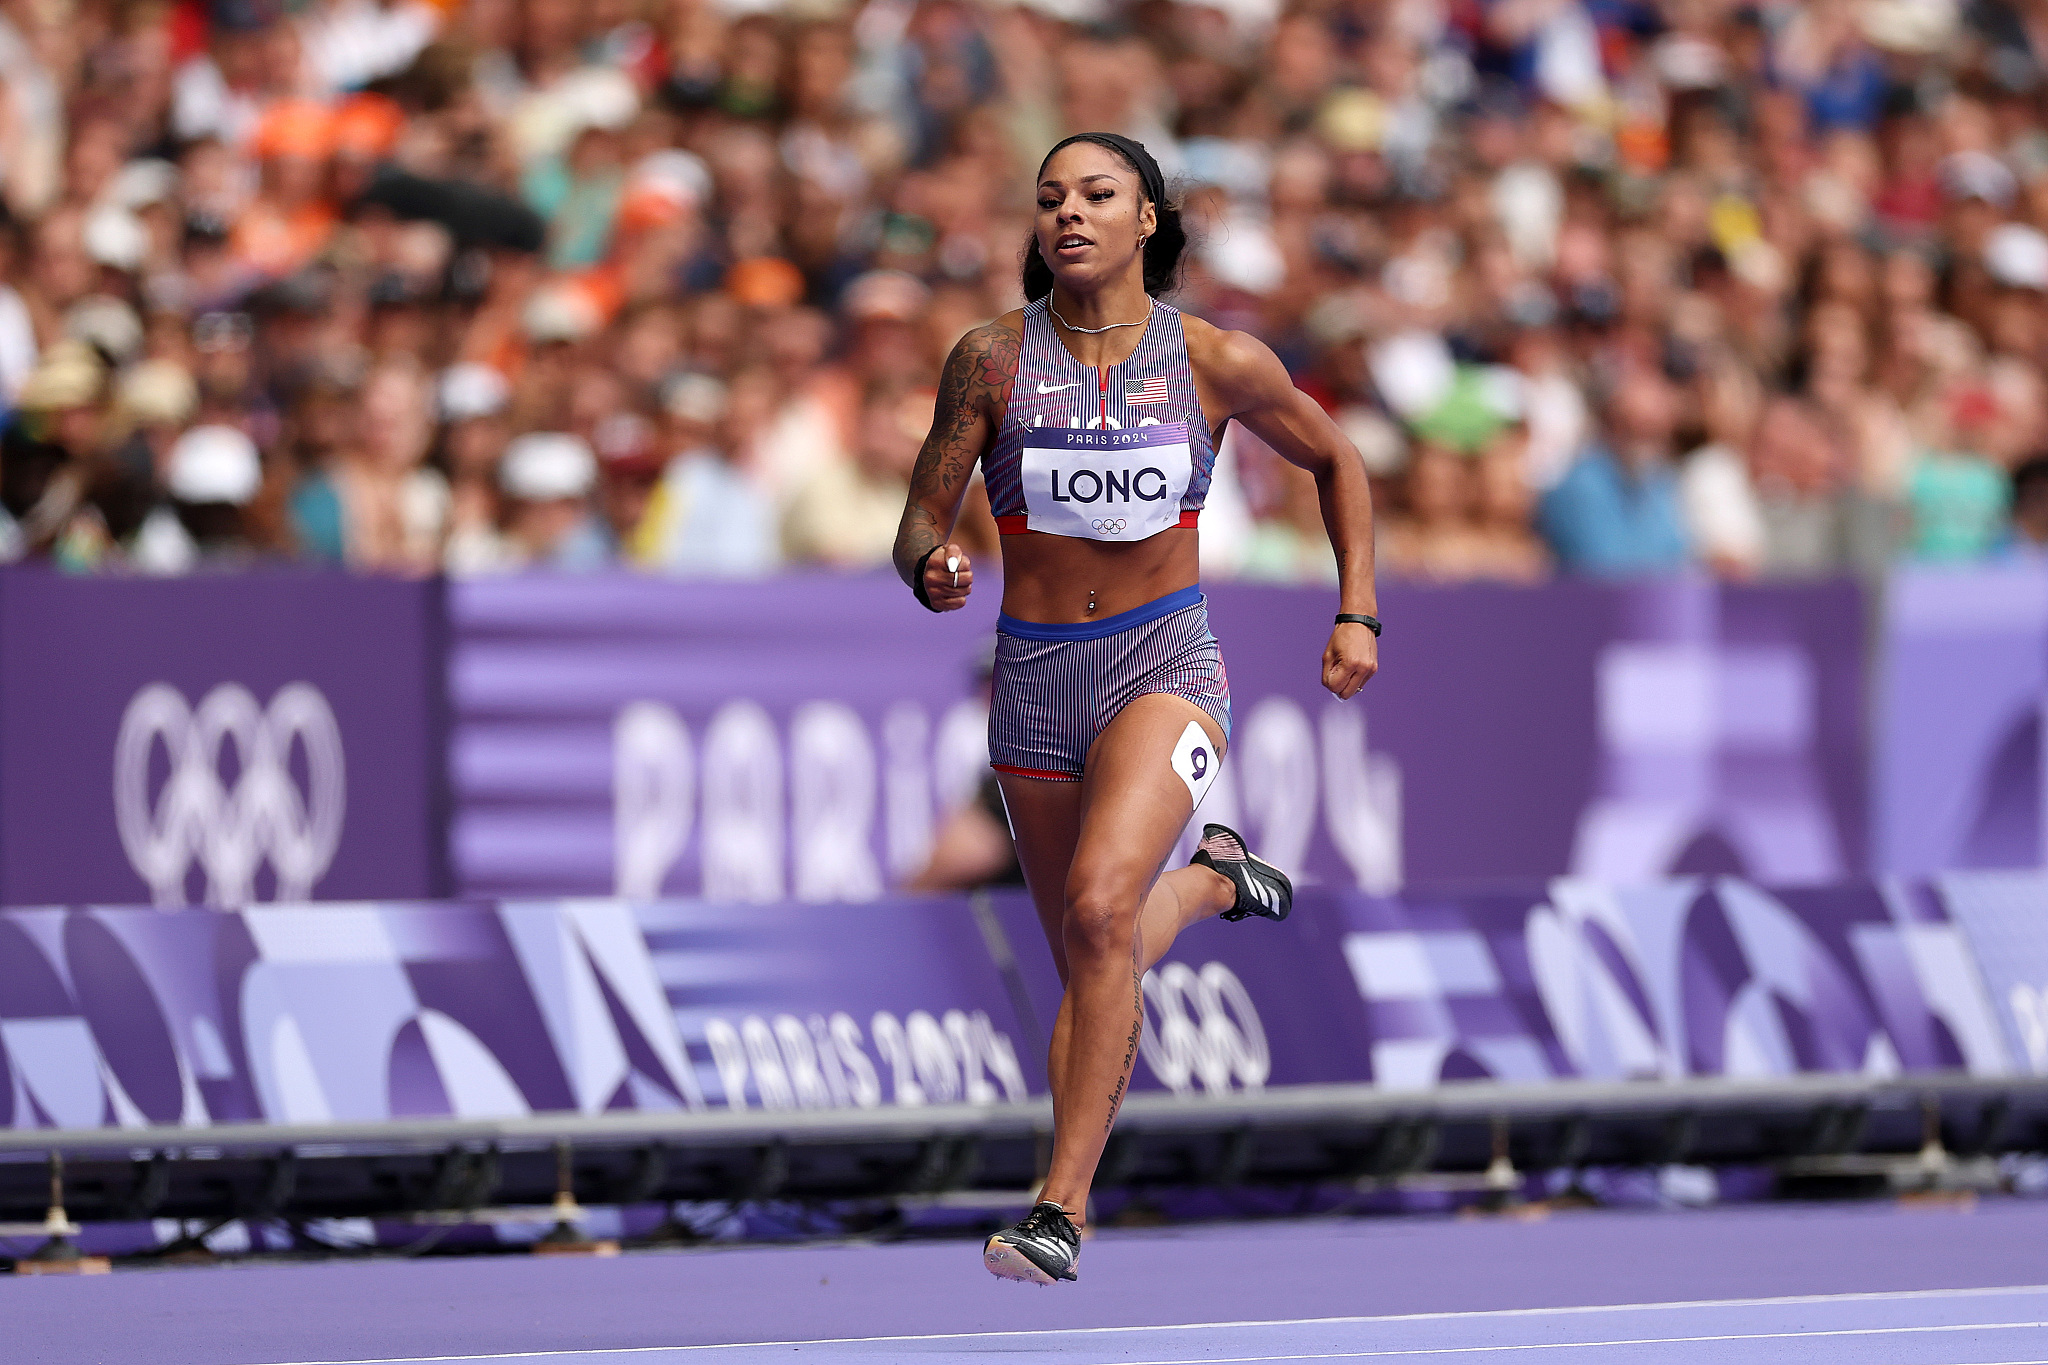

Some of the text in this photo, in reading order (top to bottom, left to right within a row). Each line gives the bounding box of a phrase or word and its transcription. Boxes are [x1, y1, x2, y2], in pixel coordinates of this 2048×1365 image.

[1112, 432, 1149, 445] 2024
[1051, 467, 1167, 504] LONG
[1190, 746, 1208, 781] 9
[871, 1008, 1029, 1109] 2024
[1124, 1020, 1142, 1071] before
[1104, 1075, 1126, 1134] anyone
